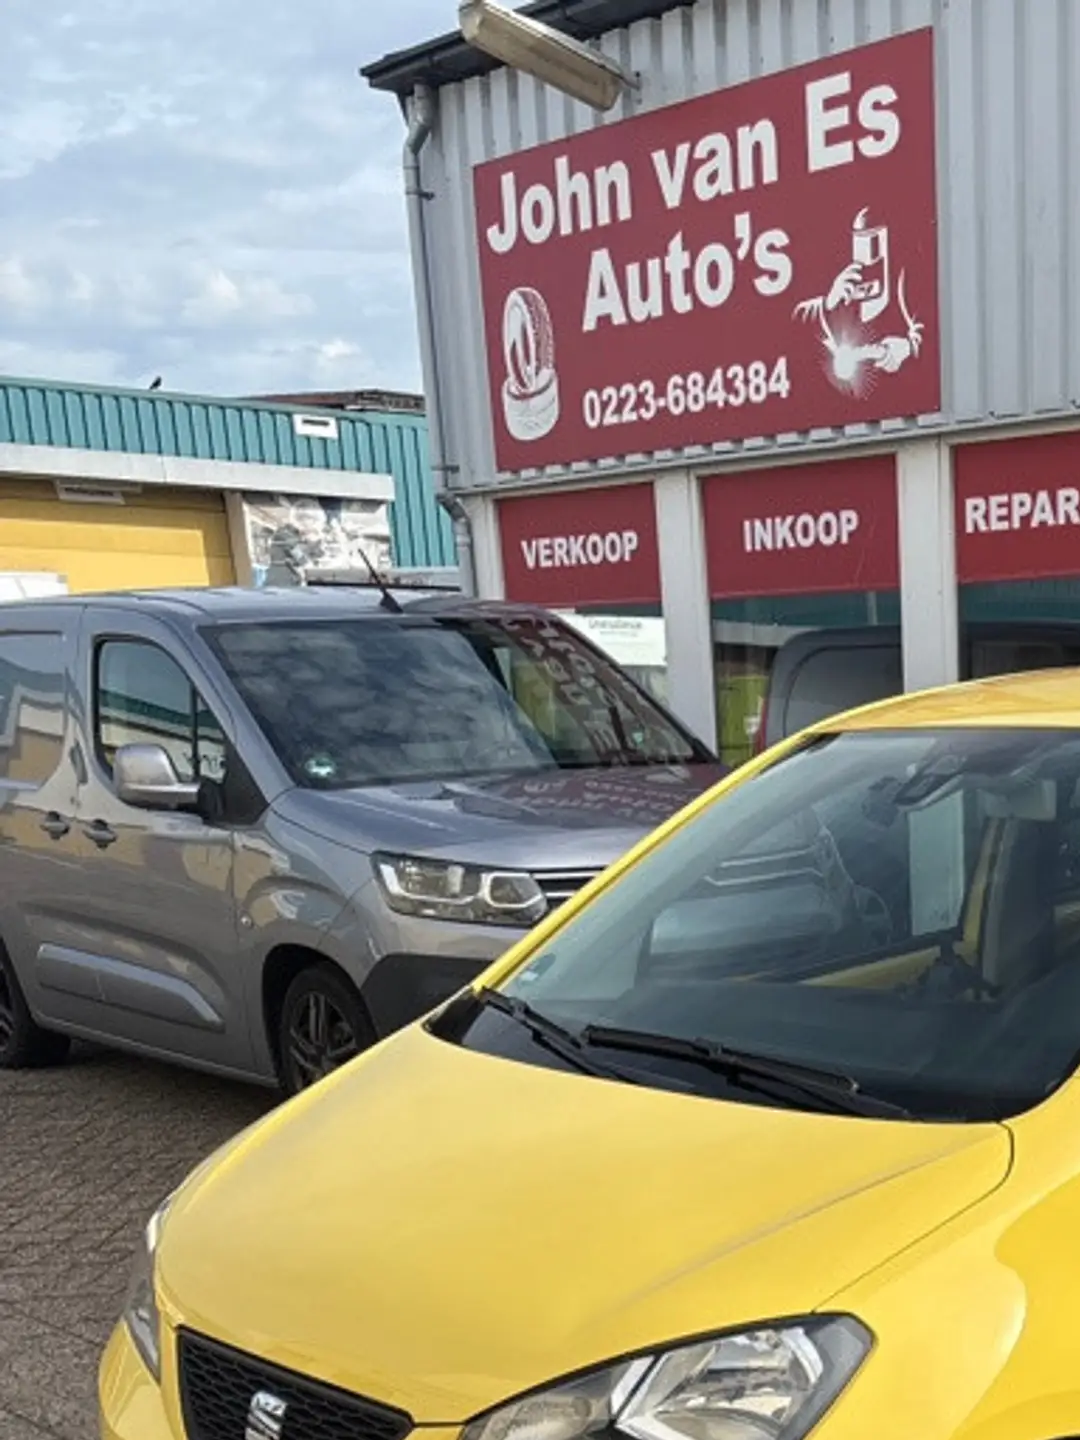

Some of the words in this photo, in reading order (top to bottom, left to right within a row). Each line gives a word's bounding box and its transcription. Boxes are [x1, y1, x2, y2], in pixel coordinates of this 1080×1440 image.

[486, 155, 632, 254] John
[651, 118, 779, 209] van
[805, 71, 901, 173] Es
[582, 211, 793, 333] Auto's
[583, 356, 791, 429] 0223-684384
[520, 531, 638, 569] VERKOOP
[743, 509, 858, 552] INKOOP
